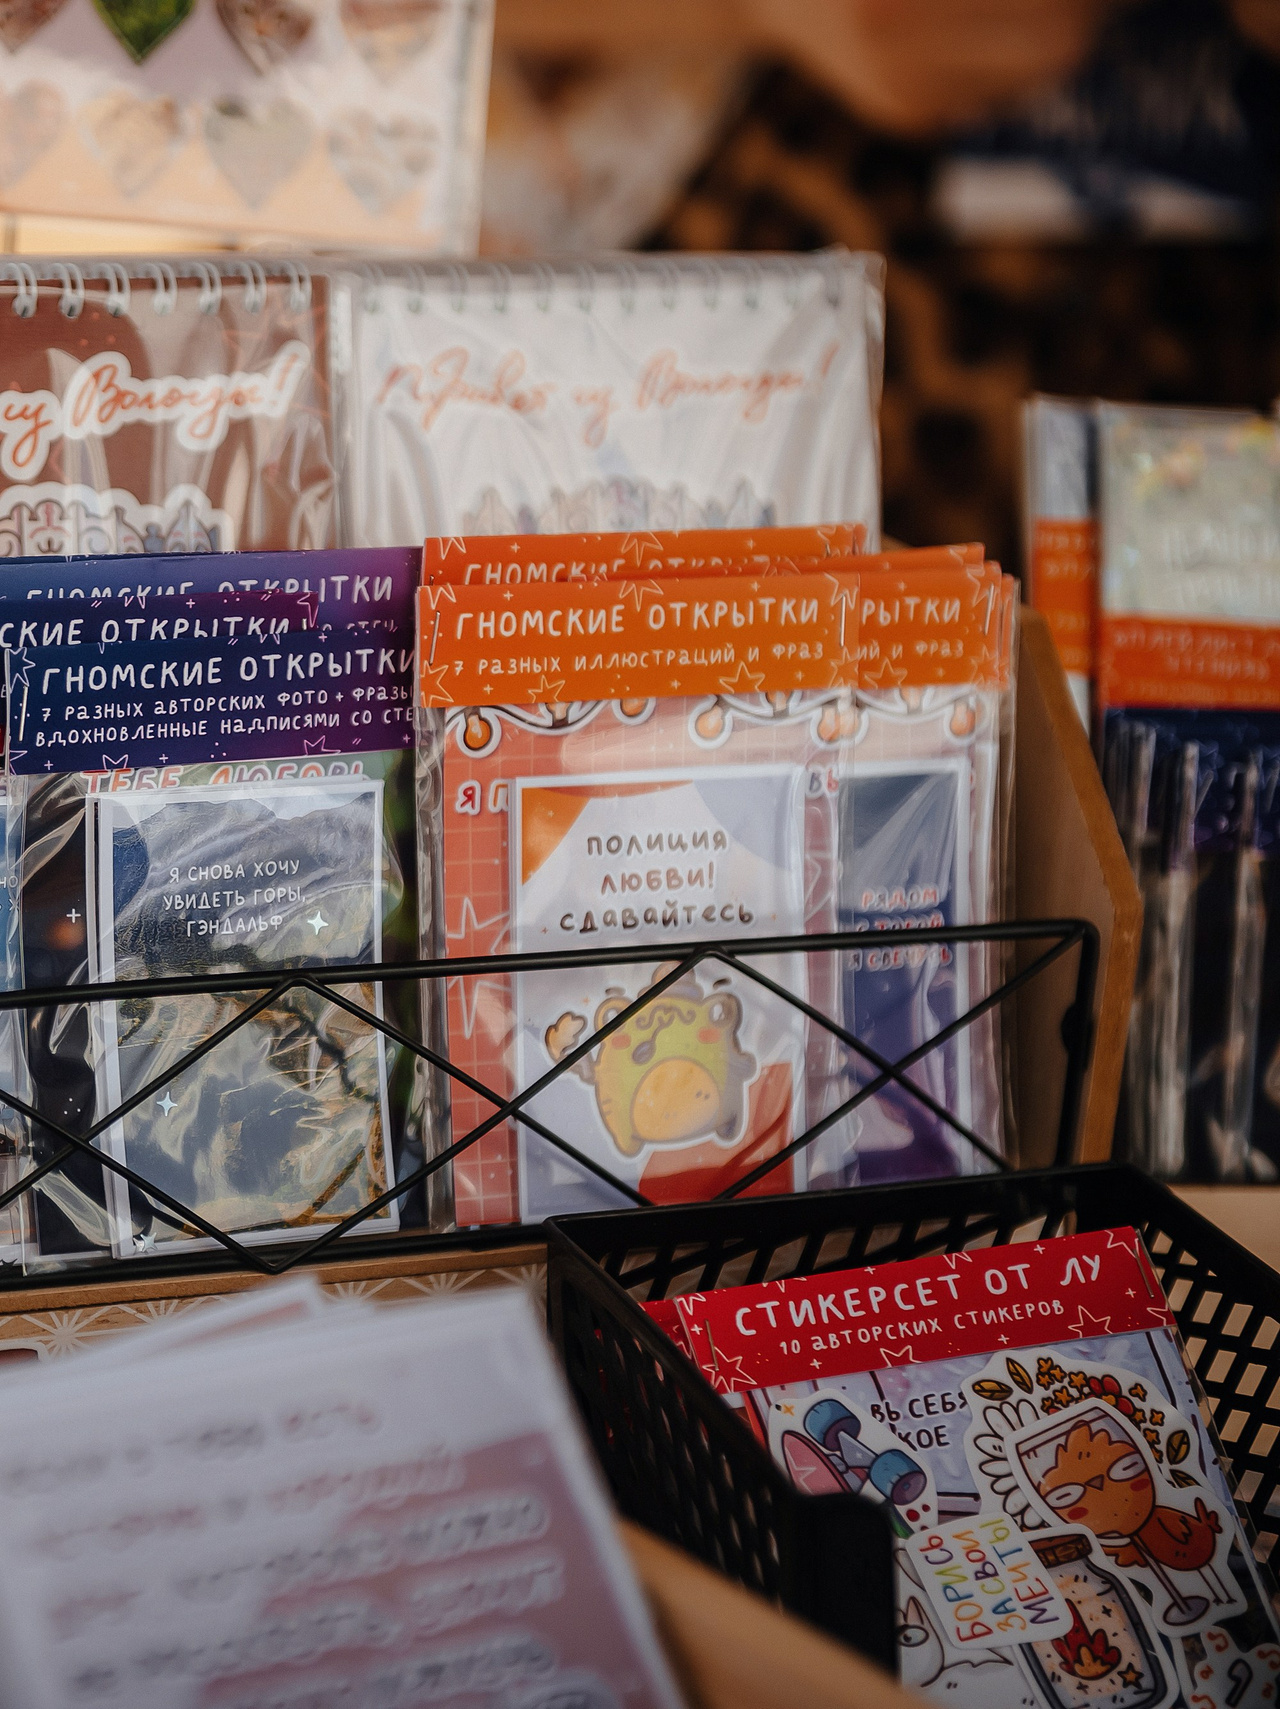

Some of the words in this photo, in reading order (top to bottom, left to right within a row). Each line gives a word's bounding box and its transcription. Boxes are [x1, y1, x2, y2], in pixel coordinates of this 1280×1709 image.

[456, 603, 626, 640] ГНОМСКИЕ
[647, 597, 819, 631] ОТКРЫТКИ
[861, 596, 962, 627] РЫТКИ
[101, 615, 289, 644] ОТКРЫТКИ
[42, 656, 223, 695] ГНОМСКИЕ
[239, 648, 415, 682] ОТКРЫТКИ
[454, 660, 464, 676] 7
[35, 719, 208, 748] ВДОХНОВЛЕННЫЕ
[350, 709, 372, 726] СО
[41, 707, 52, 722] 7
[586, 829, 729, 856] ПОЛИЦИЯ
[169, 866, 180, 885] Я
[187, 863, 247, 883] СНОВА
[253, 859, 301, 878] ХОЧУ
[600, 861, 715, 896] ЛЮБВИ!
[163, 890, 246, 912] УВИДЕТЬ
[186, 914, 283, 938] ГЭНДАЛЬФ
[735, 1272, 962, 1337] СТИКЕРСЕТ
[983, 1262, 1031, 1296] ОТ
[1059, 1253, 1102, 1286] ЛУ
[779, 1338, 802, 1357] 10
[953, 1298, 1065, 1330] СТИКЕРОВ
[951, 1529, 1006, 1595] СВОИ
[978, 1518, 1060, 1625] МЕЧТЫ
[919, 1533, 994, 1642] БОРИСЬ
[991, 1597, 1027, 1632] ЗА
